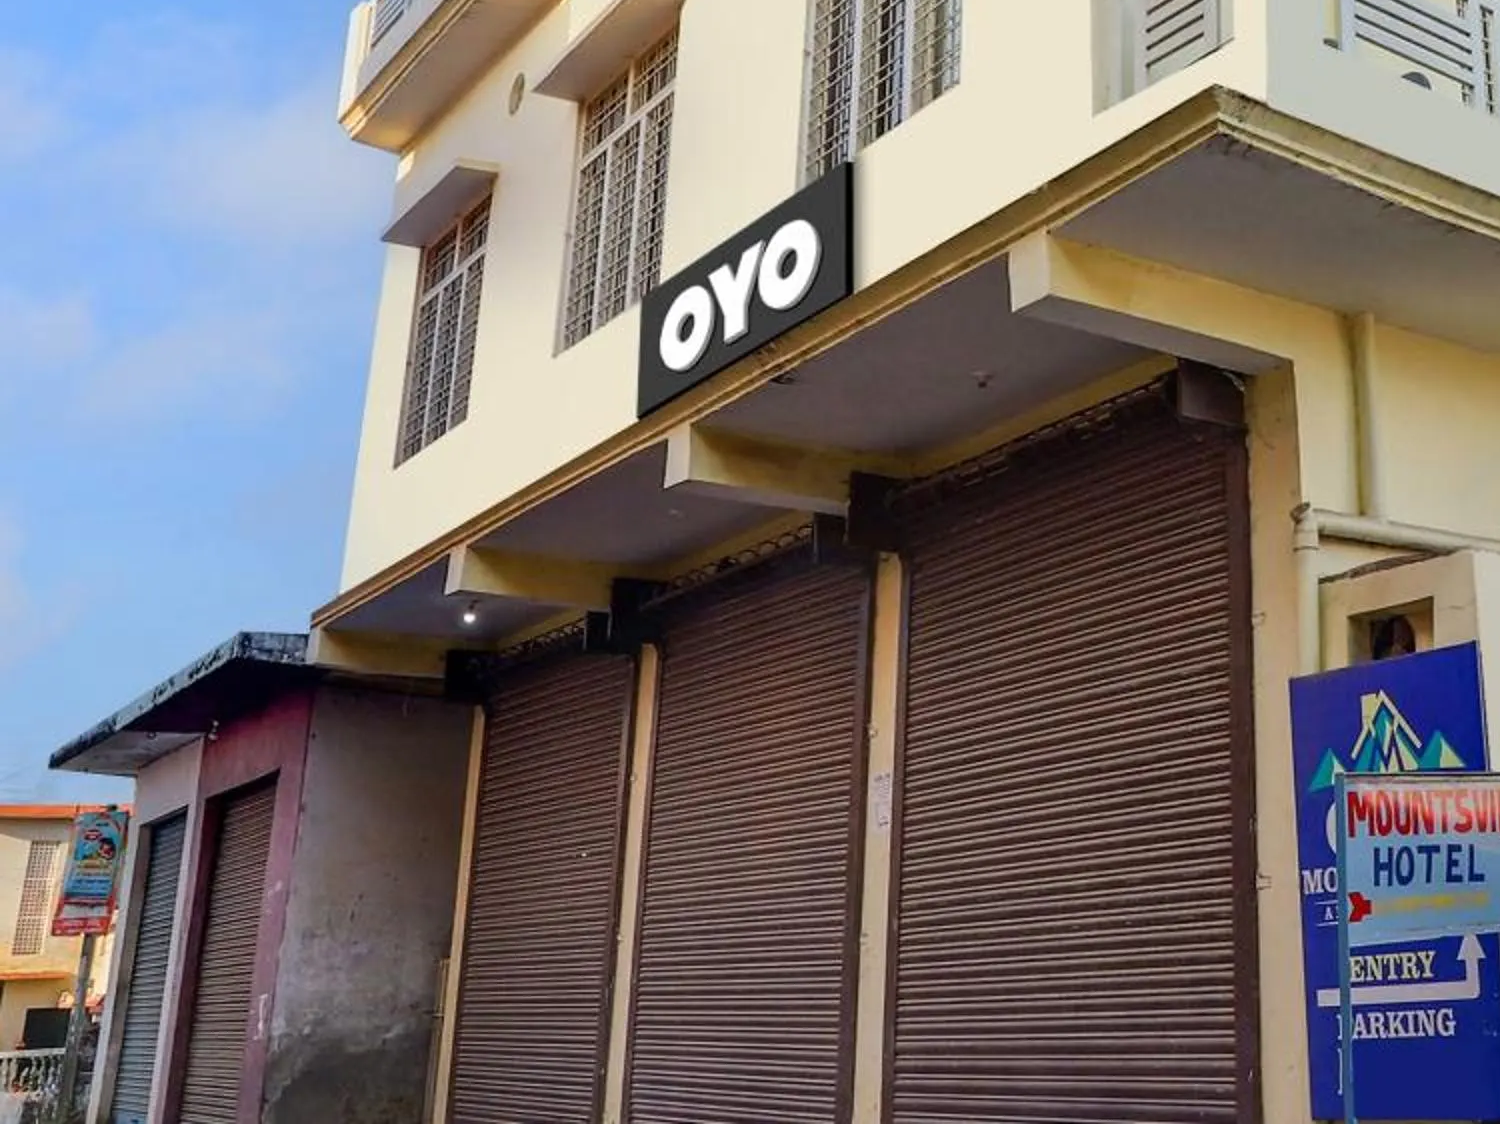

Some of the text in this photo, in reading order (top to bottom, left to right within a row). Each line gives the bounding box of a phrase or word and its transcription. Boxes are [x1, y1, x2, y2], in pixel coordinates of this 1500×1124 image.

[659, 219, 822, 372] OYO
[1373, 843, 1486, 887] HOTEL
[1349, 950, 1436, 983] ENTRY
[1336, 1007, 1457, 1041] ARKING
